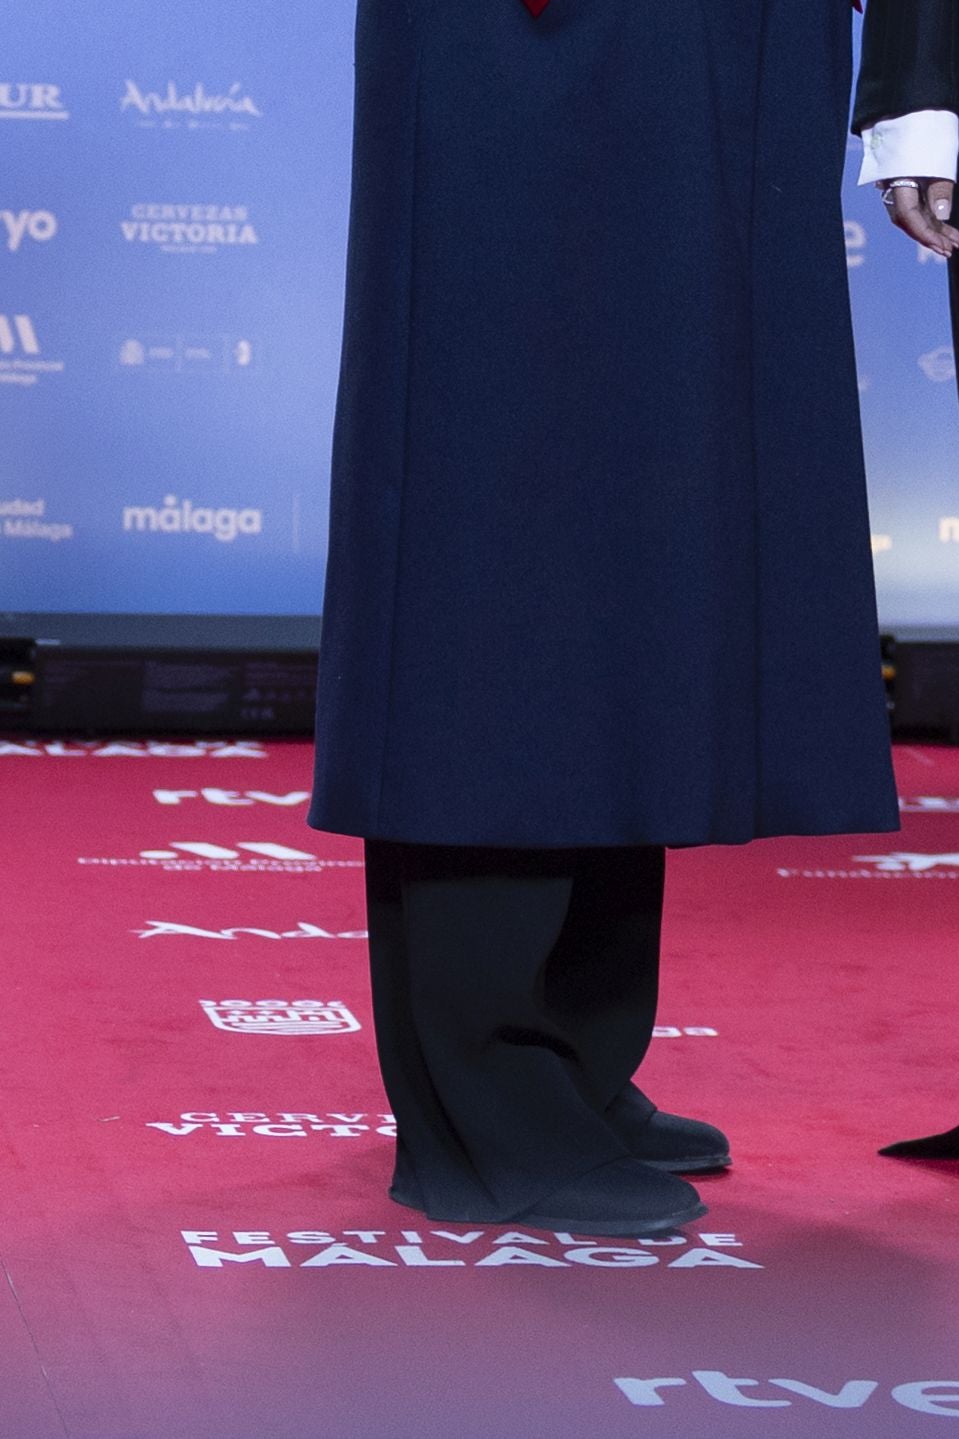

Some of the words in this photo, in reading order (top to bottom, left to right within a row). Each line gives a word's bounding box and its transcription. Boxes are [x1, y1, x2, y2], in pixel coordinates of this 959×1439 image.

[120, 221, 258, 245] VICTORIA
[123, 494, 262, 543] málaga
[180, 1230, 598, 1245] FESTIVAL
[188, 1242, 766, 1269] MÁLAGA
